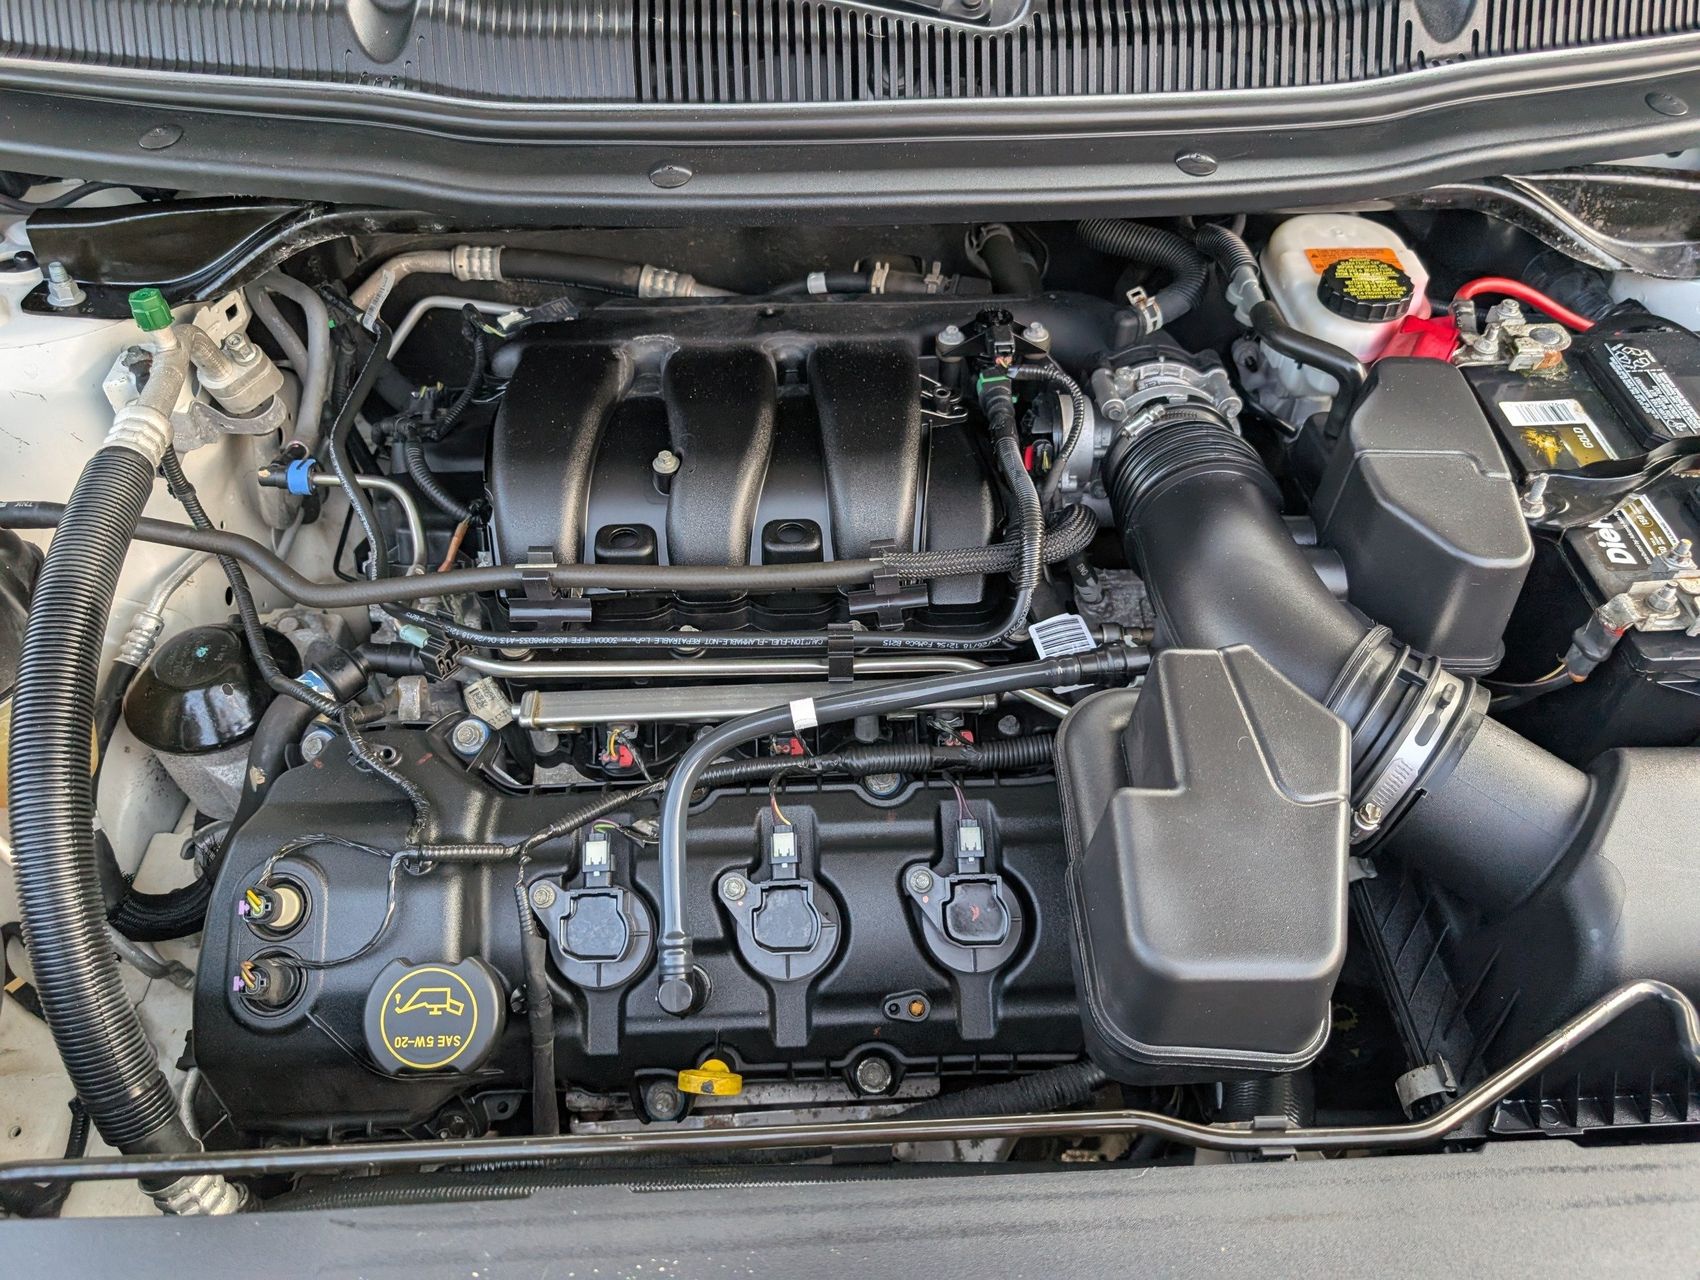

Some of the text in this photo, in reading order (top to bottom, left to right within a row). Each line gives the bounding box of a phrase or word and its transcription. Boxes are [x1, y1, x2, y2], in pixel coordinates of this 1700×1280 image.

[1572, 426, 1595, 449] GOLD
[461, 631, 497, 643] 04/26/18
[499, 637, 568, 645] WSS-M98D33-A13
[653, 637, 701, 645] REPAIRABLE
[882, 639, 902, 647] B215
[904, 640, 933, 648] FoMoCo
[936, 642, 959, 650] 12:54
[394, 1035, 462, 1049] SAE 5W-20
